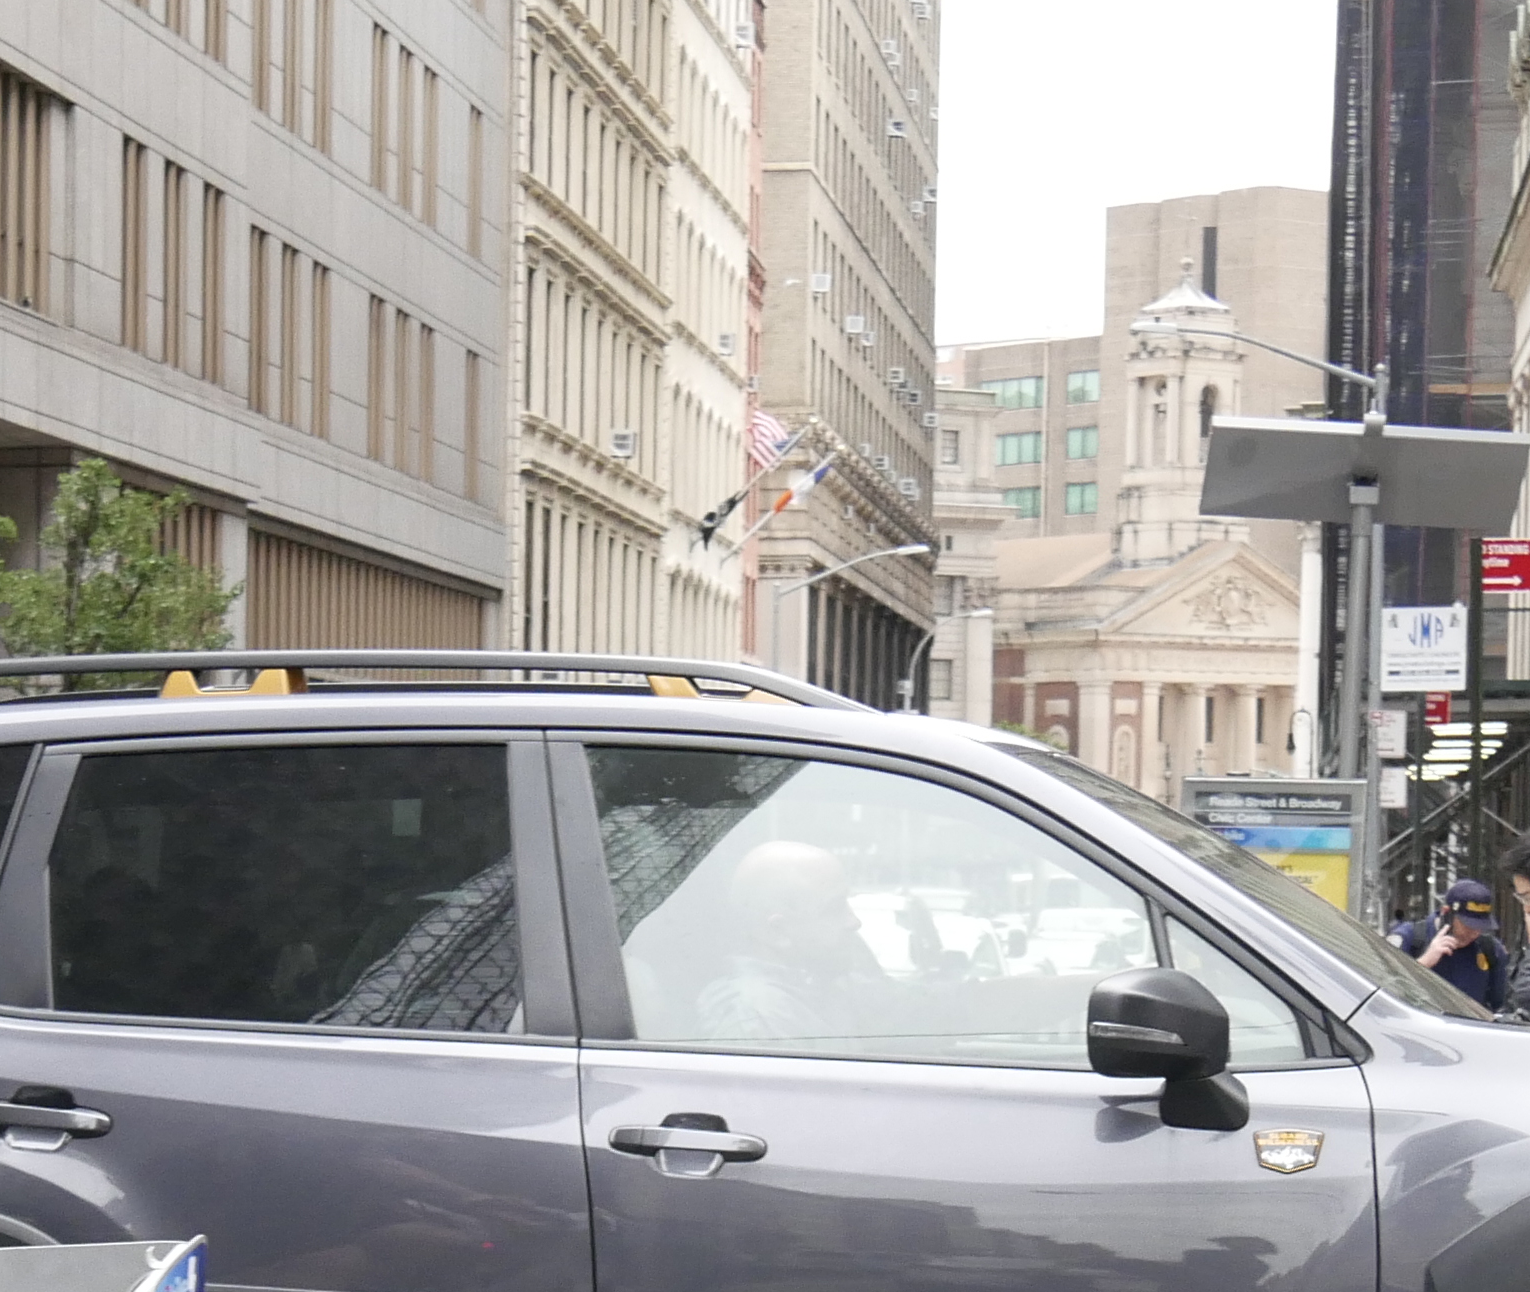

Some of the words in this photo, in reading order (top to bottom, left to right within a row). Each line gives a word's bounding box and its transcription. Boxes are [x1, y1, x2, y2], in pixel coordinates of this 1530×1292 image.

[1488, 544, 1530, 555] STANDING
[1245, 797, 1277, 808] Street
[1278, 798, 1287, 808] &
[1289, 797, 1343, 811] Broadway
[1209, 812, 1235, 823] Civic
[1236, 813, 1273, 824] Center
